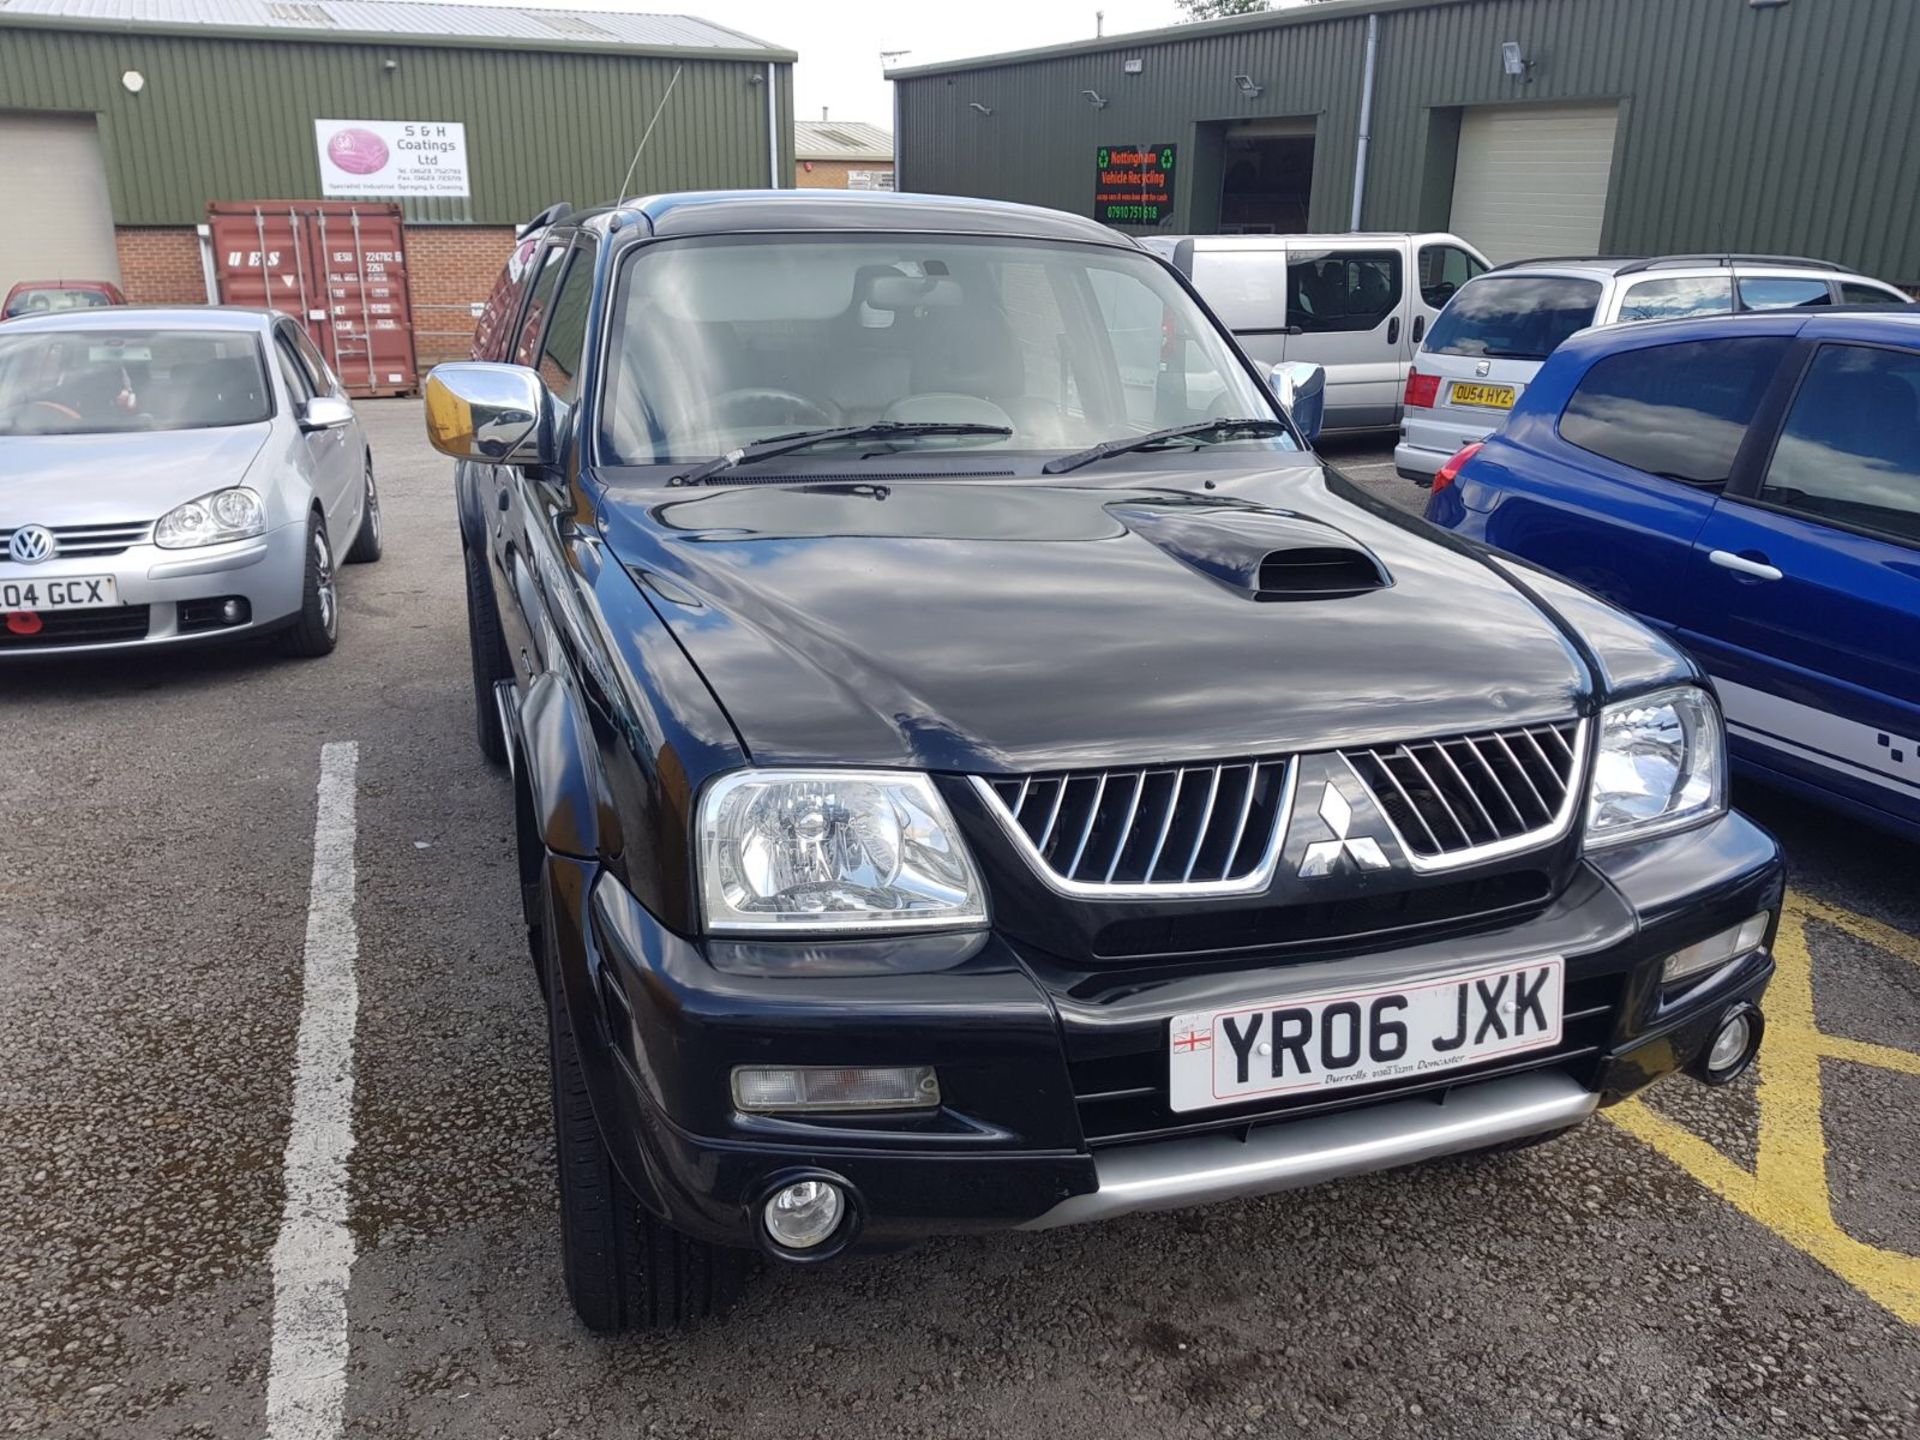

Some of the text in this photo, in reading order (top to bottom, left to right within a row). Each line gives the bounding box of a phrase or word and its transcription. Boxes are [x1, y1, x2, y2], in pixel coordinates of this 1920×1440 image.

[405, 126, 446, 137] S & H
[397, 139, 456, 153] Coatings
[418, 155, 438, 165] Ltd
[1111, 151, 1156, 166] Nottingham
[1102, 171, 1164, 187] Vehicle Recycling
[1486, 389, 1510, 404] HYZ
[48, 580, 103, 605] GCX
[1222, 967, 1551, 1084] YR06 JXK
[1417, 1055, 1465, 1071] Doncaster
